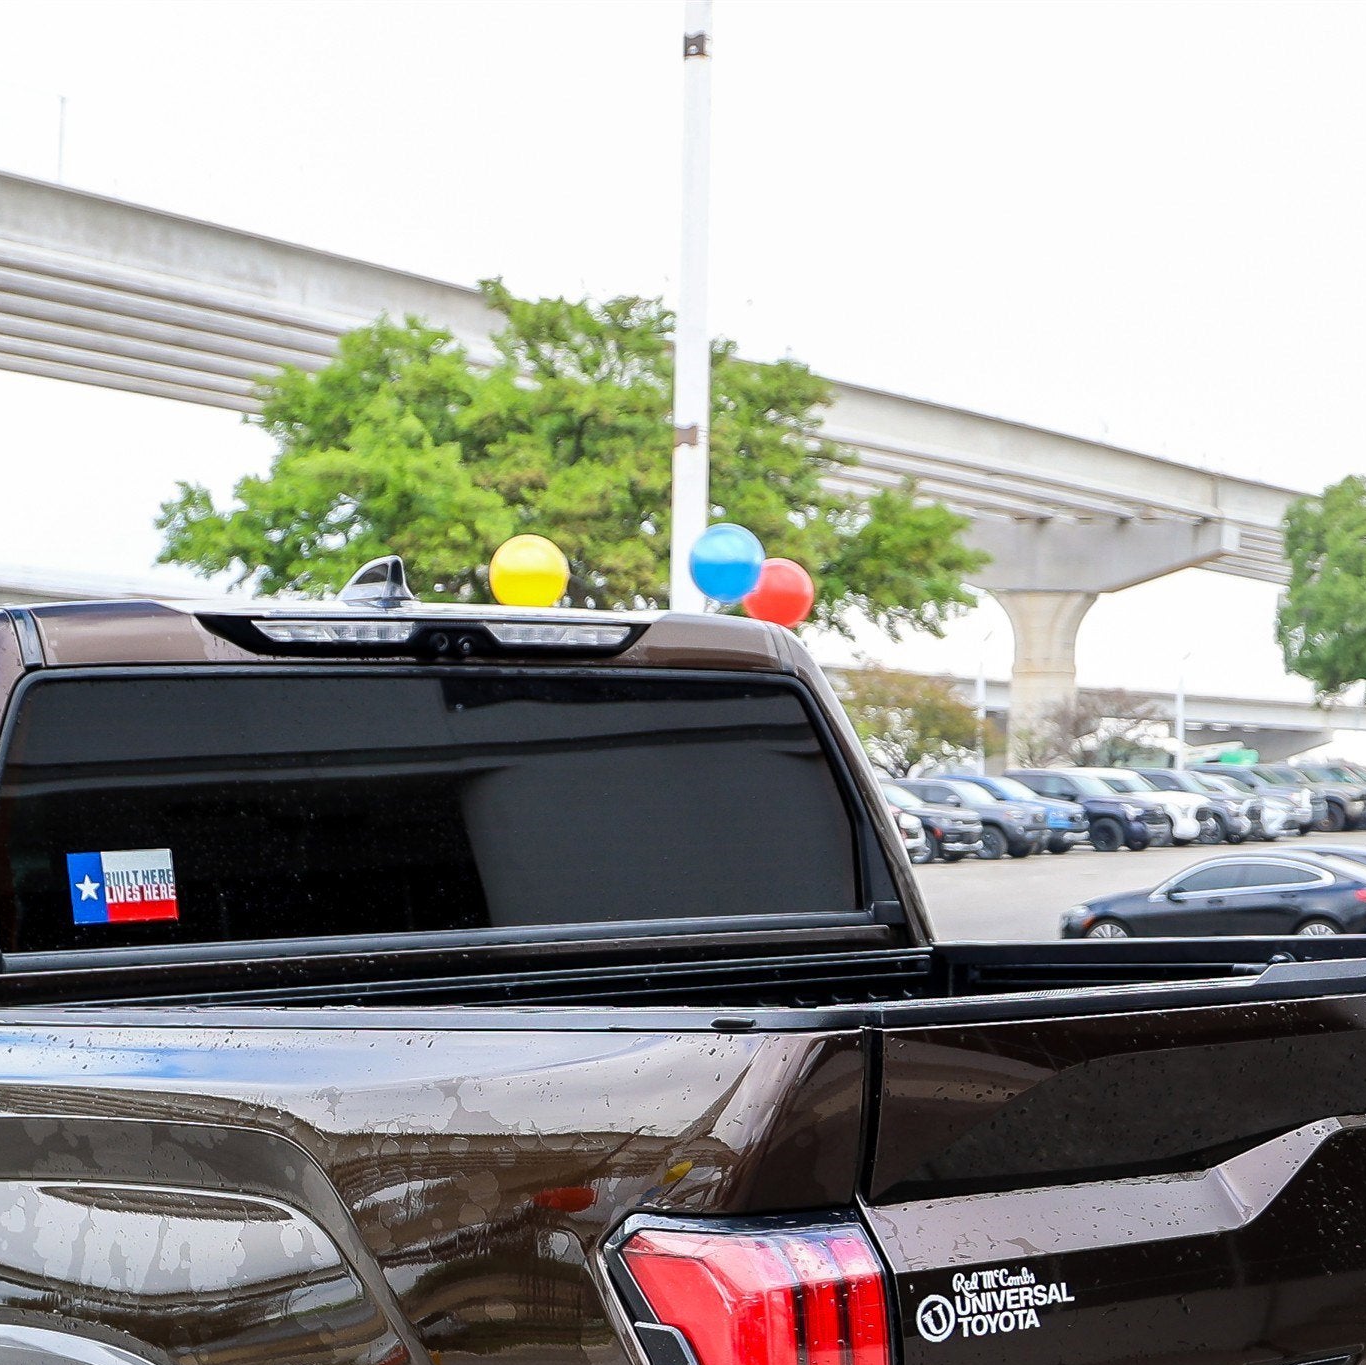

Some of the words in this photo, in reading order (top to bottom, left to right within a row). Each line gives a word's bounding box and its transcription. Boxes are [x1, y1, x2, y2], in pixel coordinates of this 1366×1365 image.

[104, 870, 139, 887] BUILT
[141, 868, 174, 885] HERE
[106, 885, 142, 903] LIVES
[143, 884, 177, 901] HERE
[952, 1272, 979, 1296] Red
[954, 1282, 1075, 1316] UNIVERSAL
[957, 1308, 1041, 1338] TOYOTA
